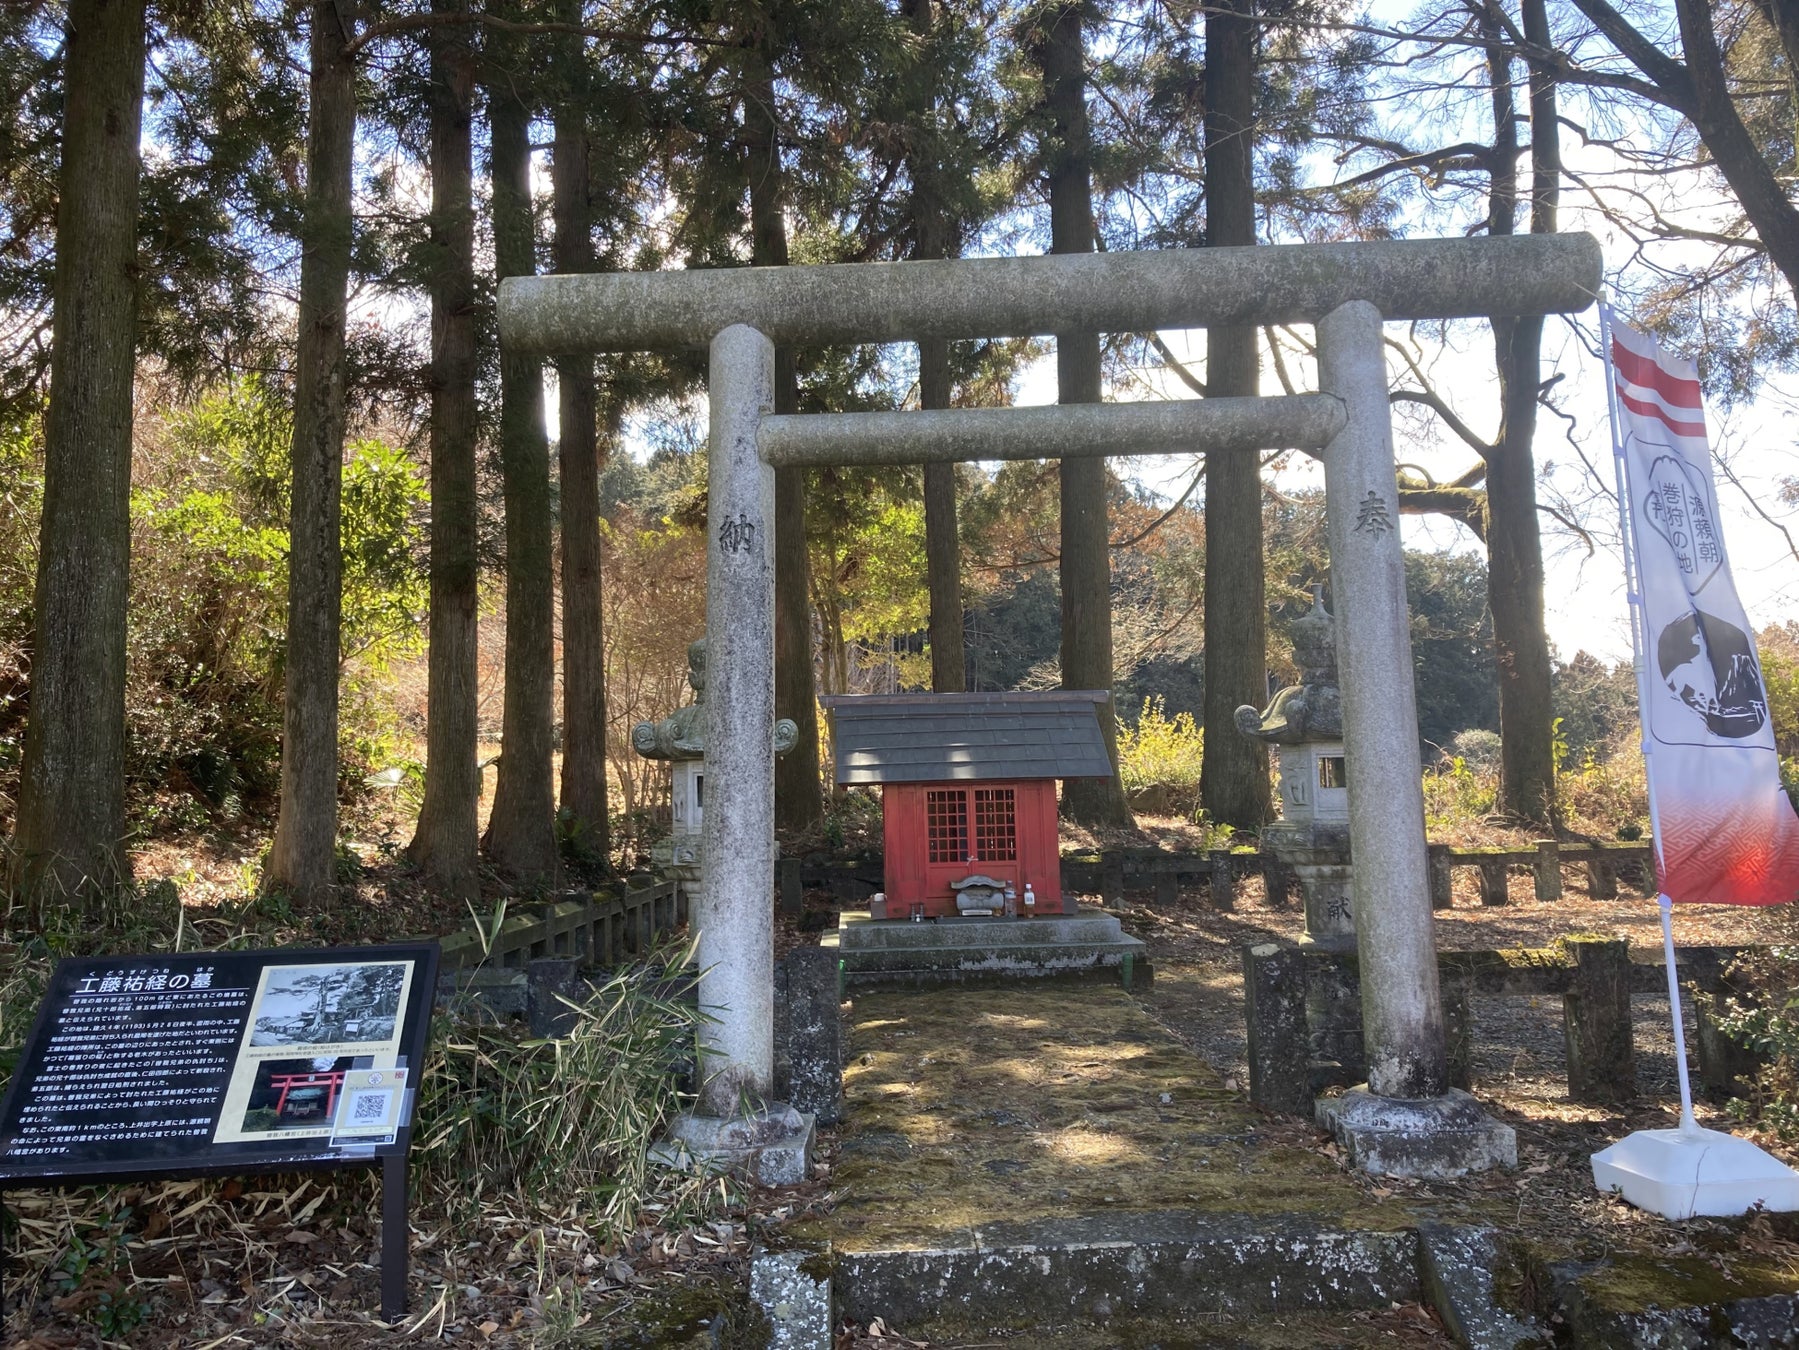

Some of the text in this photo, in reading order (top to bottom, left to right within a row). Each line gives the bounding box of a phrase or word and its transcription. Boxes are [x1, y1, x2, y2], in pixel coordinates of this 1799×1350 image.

[719, 513, 756, 555] 納
[1353, 490, 1394, 541] 奉
[1662, 482, 1694, 574] 巻狩の地
[1689, 495, 1719, 564] 源頼朝
[75, 972, 214, 994] 工藤祐経の墓
[18, 1115, 53, 1123] きました。
